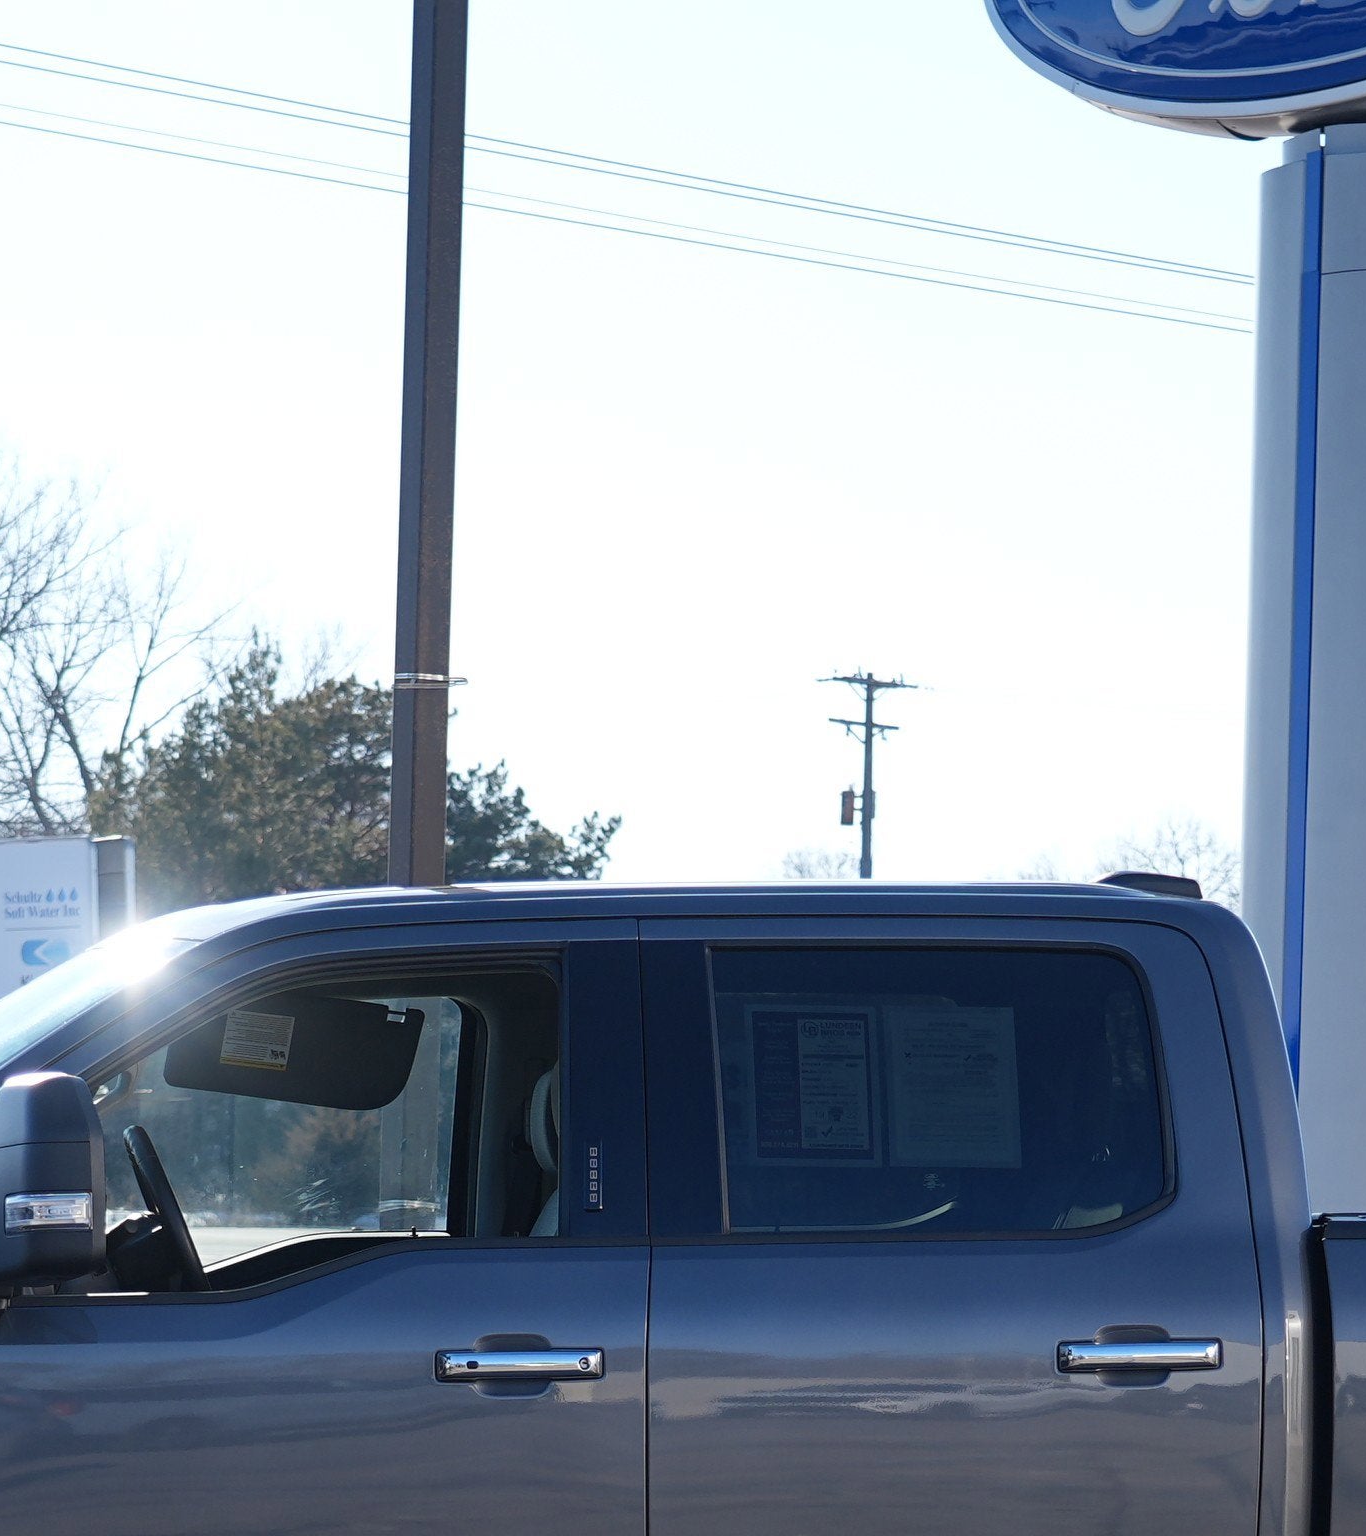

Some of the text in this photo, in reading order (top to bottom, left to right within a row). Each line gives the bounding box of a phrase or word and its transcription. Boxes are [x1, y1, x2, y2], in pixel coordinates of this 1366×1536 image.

[4, 890, 43, 904] Schultz
[4, 904, 81, 919] Soft Water Inc
